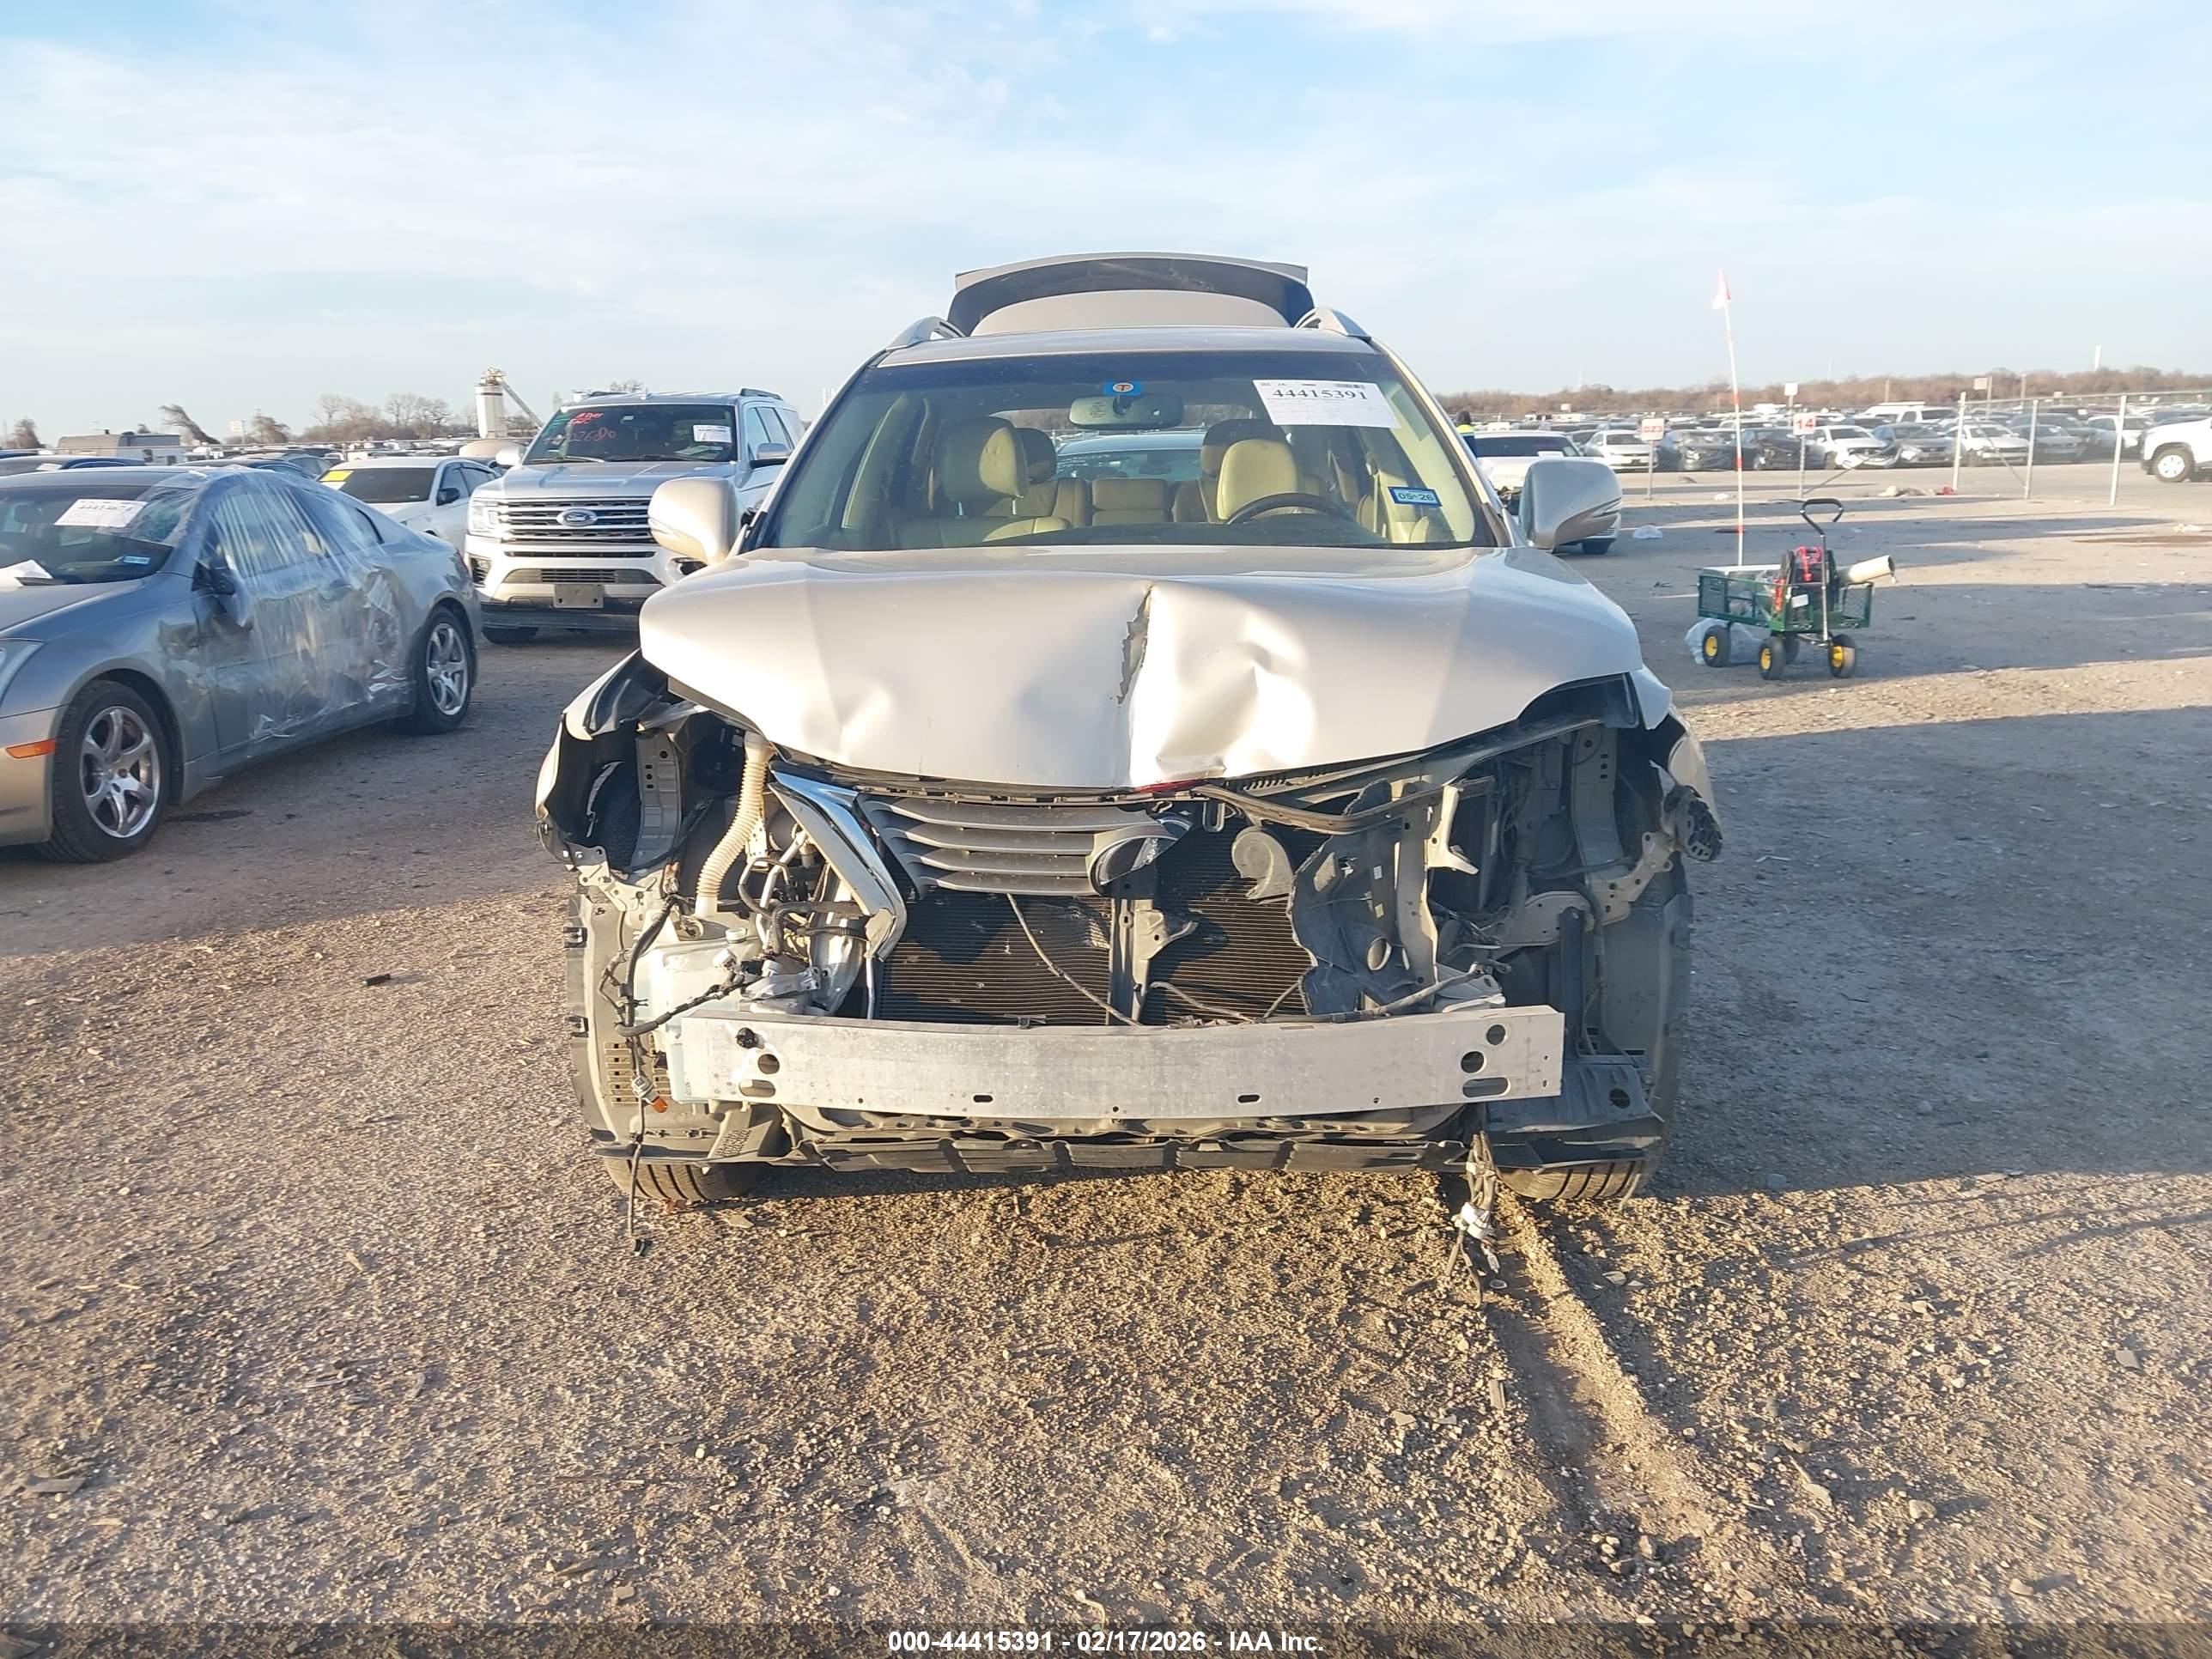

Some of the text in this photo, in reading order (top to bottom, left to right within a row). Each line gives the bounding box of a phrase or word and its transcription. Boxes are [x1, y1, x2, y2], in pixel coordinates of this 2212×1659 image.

[1273, 389, 1368, 400] 44415391
[1797, 418, 1814, 429] 14
[1398, 493, 1435, 501] 05-26
